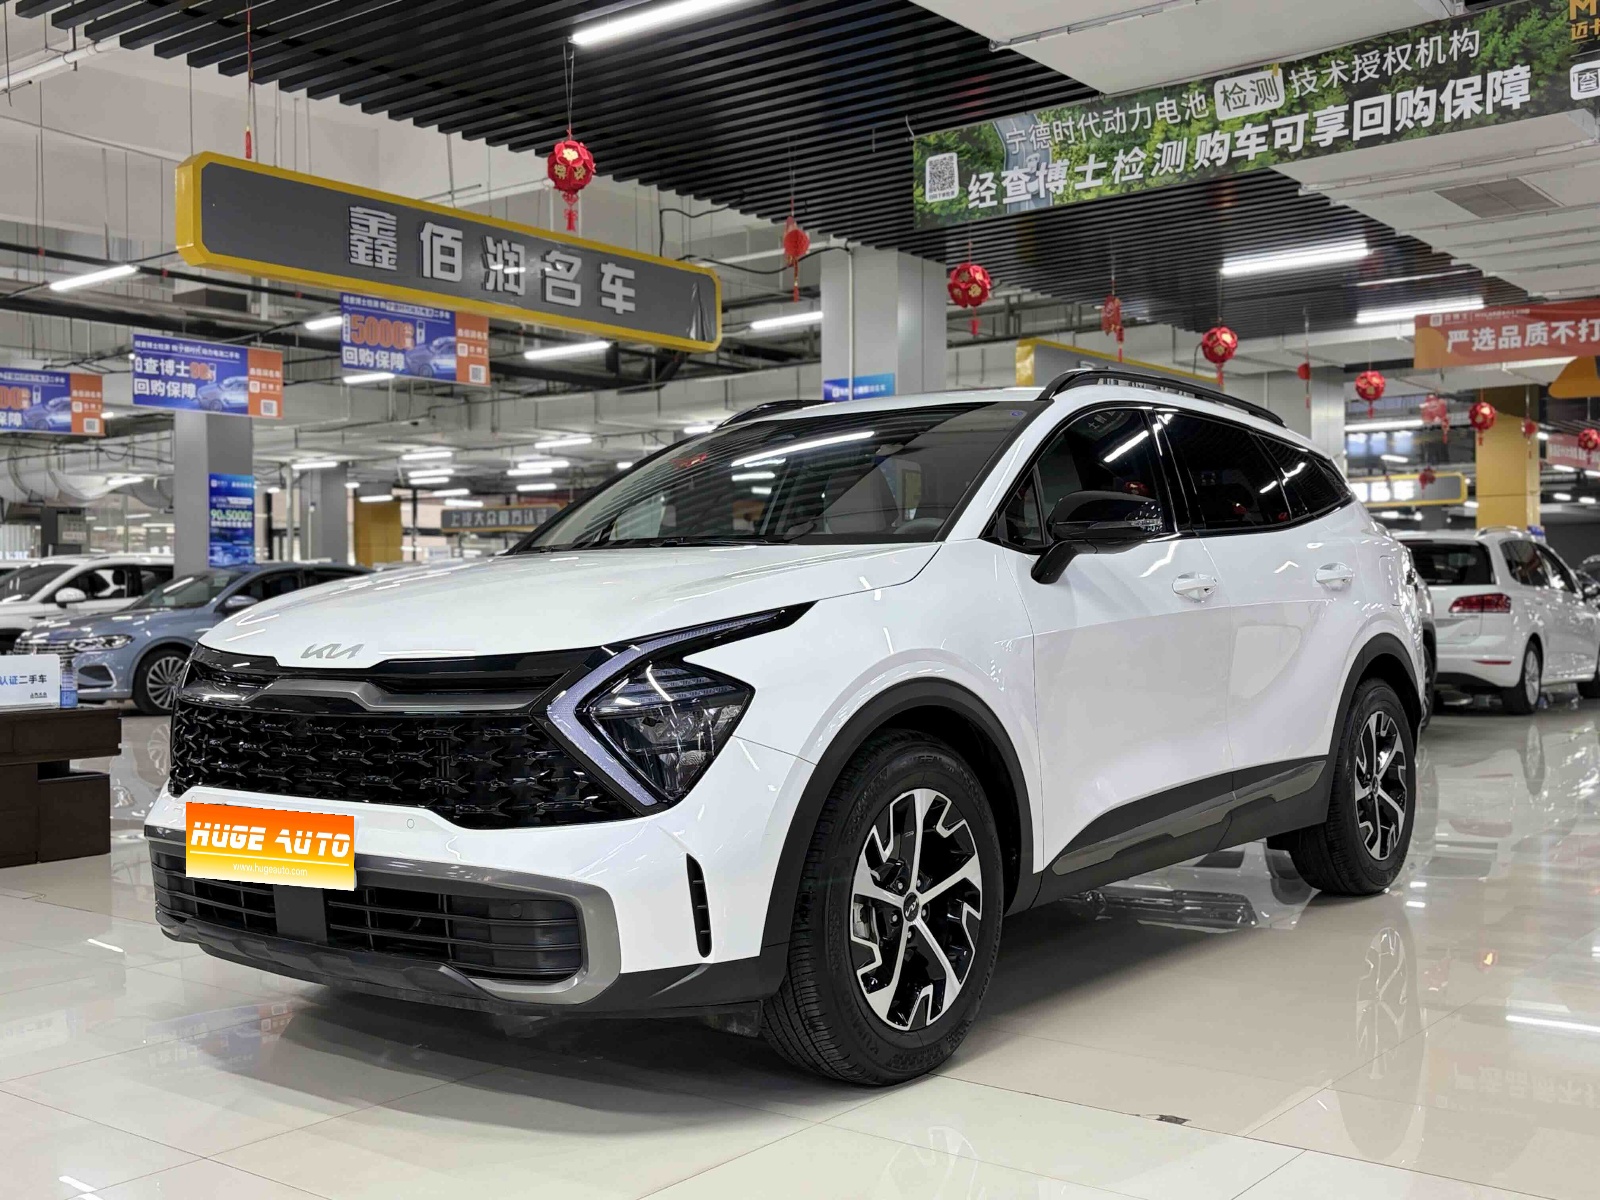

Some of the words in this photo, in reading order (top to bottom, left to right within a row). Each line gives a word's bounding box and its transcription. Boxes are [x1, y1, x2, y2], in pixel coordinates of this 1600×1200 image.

[1006, 91, 1207, 155] 宁德时代动力电池
[1220, 71, 1281, 112] 检测
[1289, 28, 1480, 99] 技术授权机构
[349, 205, 636, 314] 鑫佰润名车
[350, 313, 404, 350] 5000
[342, 345, 406, 371] 回购保障
[134, 378, 197, 400] 回购保障
[300, 643, 365, 659] KIA
